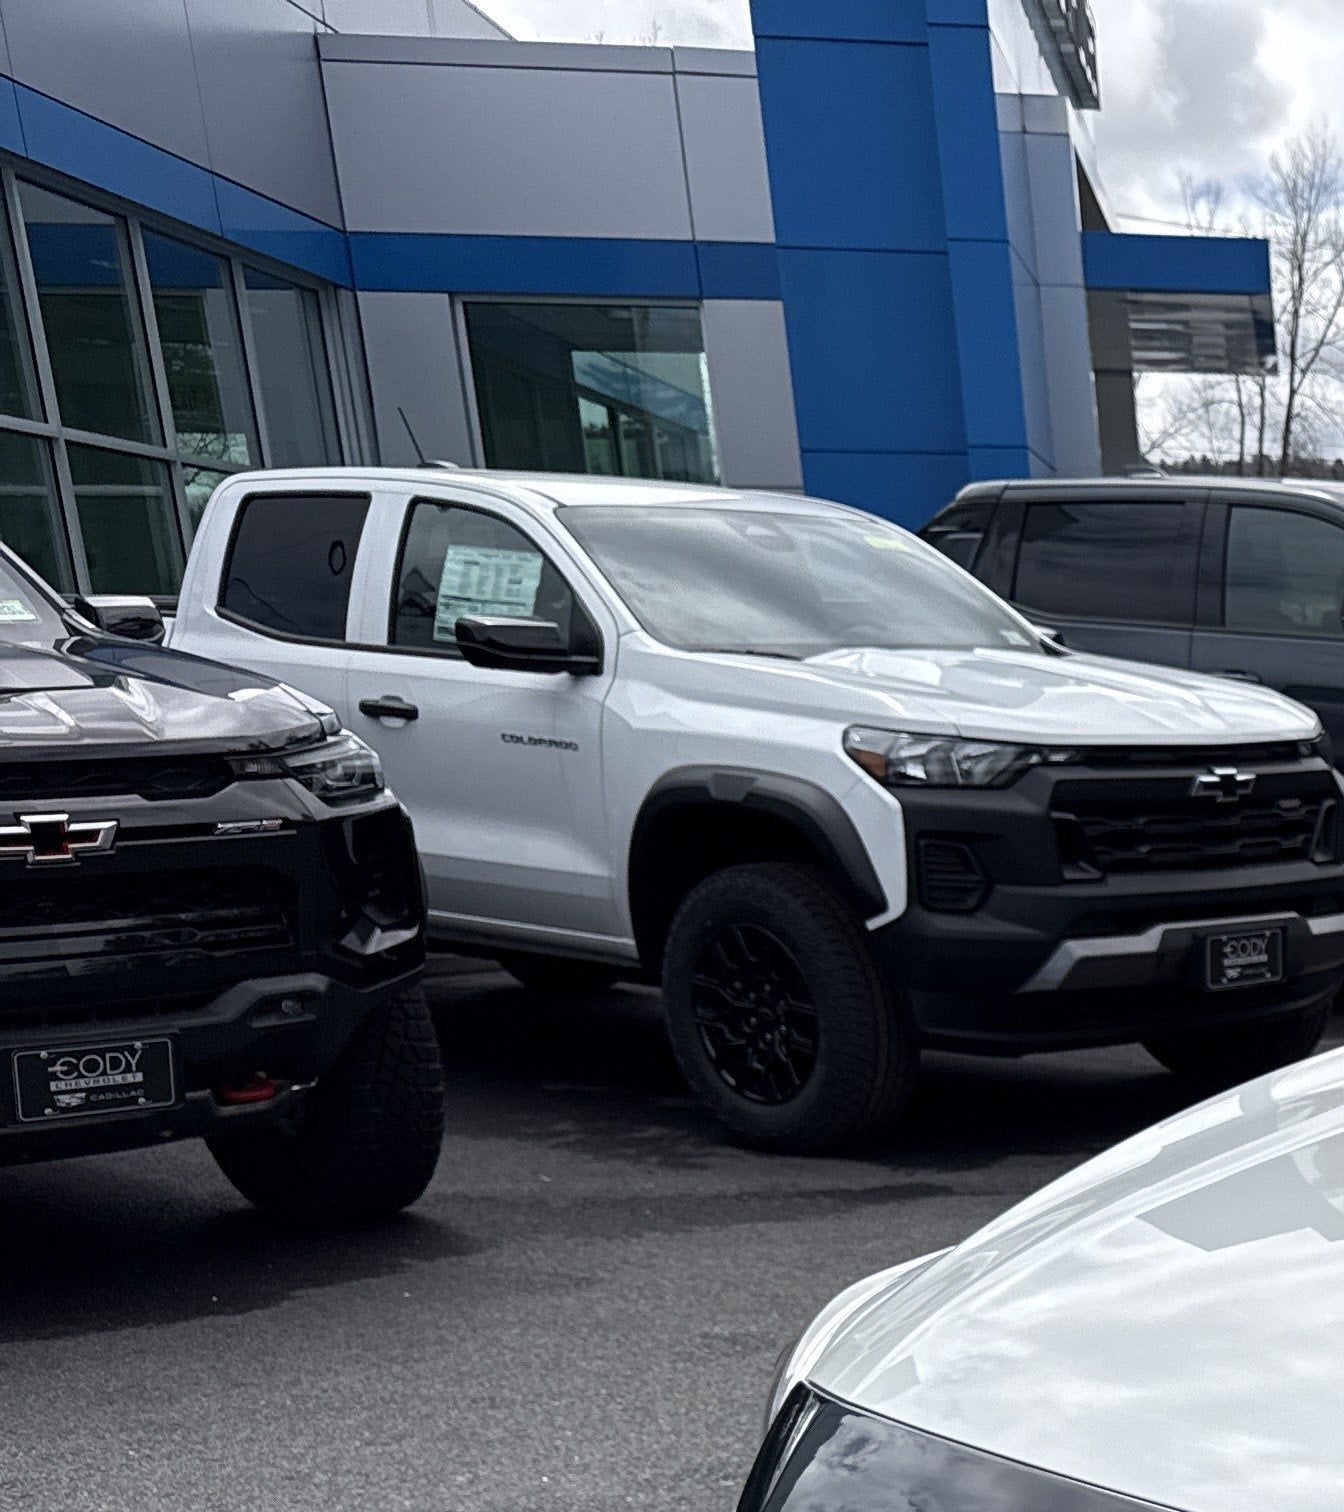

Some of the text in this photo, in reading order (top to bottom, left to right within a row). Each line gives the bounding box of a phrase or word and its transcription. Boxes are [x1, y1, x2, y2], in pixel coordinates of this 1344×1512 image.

[501, 733, 579, 752] COLORADO
[50, 1050, 142, 1080] CODY
[54, 1073, 140, 1090] CHEVROLET
